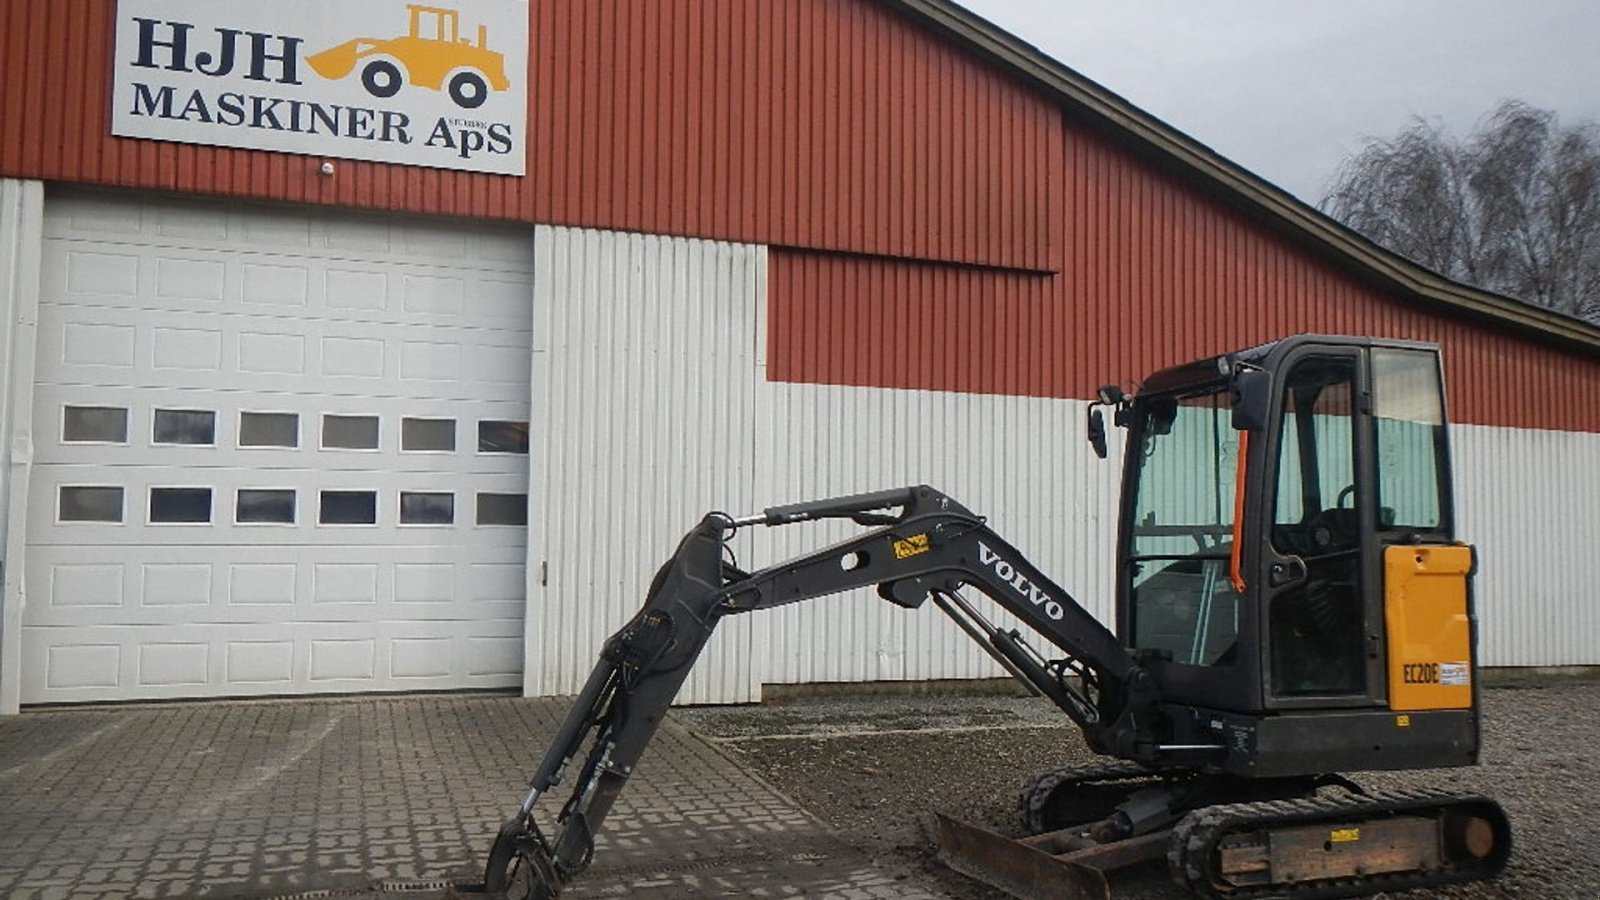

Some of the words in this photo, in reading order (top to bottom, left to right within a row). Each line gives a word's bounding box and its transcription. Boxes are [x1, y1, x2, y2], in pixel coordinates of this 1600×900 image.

[130, 17, 304, 85] HJH
[130, 83, 413, 145] MASKINER
[424, 117, 512, 159] ApS
[978, 541, 1064, 620] VOLVO
[1403, 662, 1439, 684] EC20E
